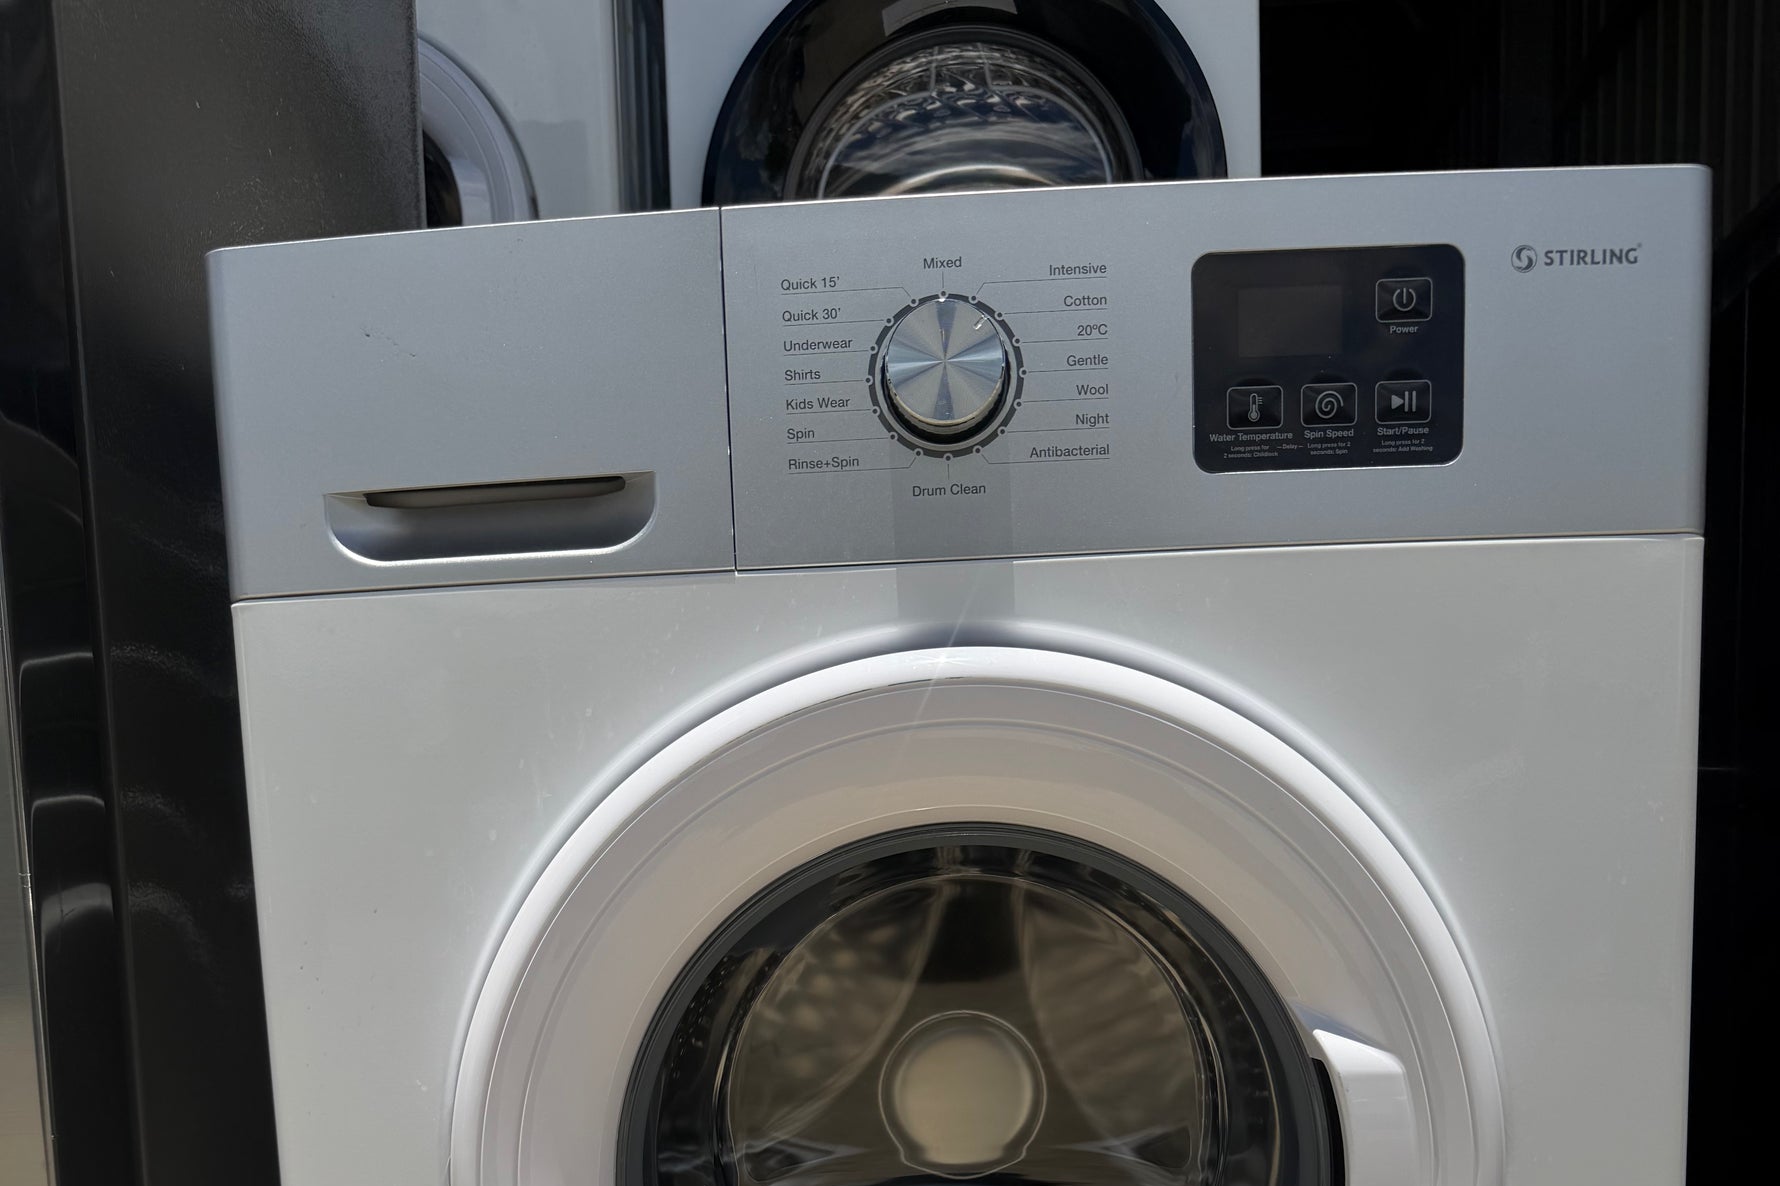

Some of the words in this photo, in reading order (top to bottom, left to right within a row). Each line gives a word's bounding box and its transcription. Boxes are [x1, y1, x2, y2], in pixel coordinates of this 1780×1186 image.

[923, 257, 962, 269] Mixed
[1544, 248, 1638, 266] STIRLING
[1049, 263, 1107, 276] Intensive
[781, 278, 817, 291] Quick
[1063, 294, 1107, 307] Cotton
[783, 309, 819, 323] Quick
[1390, 325, 1418, 334] Power
[783, 338, 853, 352] Underwear
[1067, 354, 1108, 367] Gentle
[785, 369, 821, 381] Shirts
[1077, 384, 1109, 396] Wool
[786, 398, 813, 411] Kids
[816, 397, 850, 409] Wear
[1075, 413, 1109, 427] Night
[787, 428, 815, 442] Spin
[1210, 432, 1235, 442] Water
[1238, 431, 1293, 441] Temperature
[1304, 429, 1323, 439] Spin
[1326, 429, 1354, 438] Speed
[1377, 426, 1429, 436] Start/Pause
[1030, 444, 1109, 458] Antibacterial
[788, 457, 859, 471] Rinse+Spin
[912, 485, 946, 497] Drum
[950, 483, 986, 495] Clean
